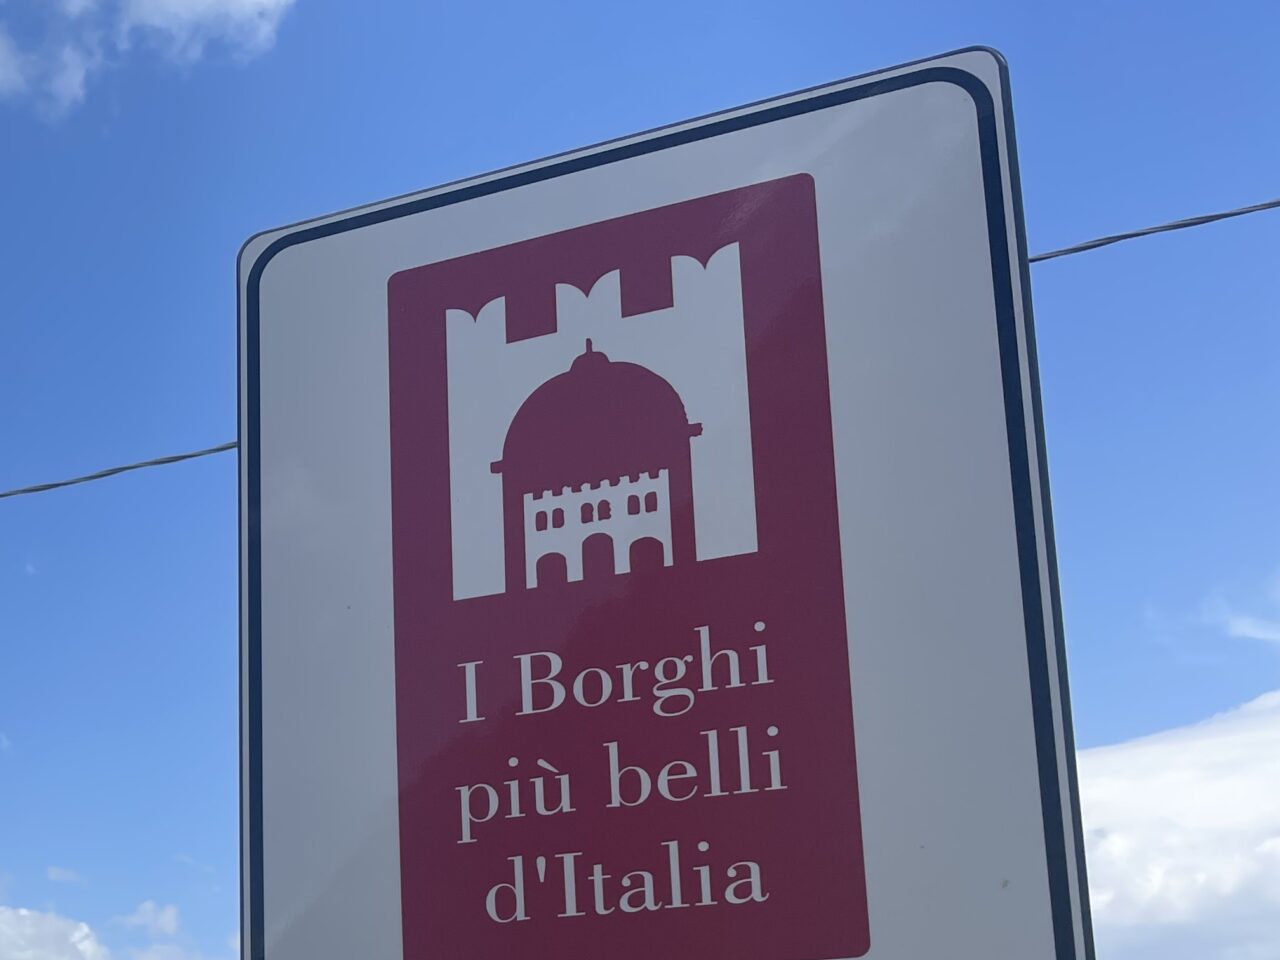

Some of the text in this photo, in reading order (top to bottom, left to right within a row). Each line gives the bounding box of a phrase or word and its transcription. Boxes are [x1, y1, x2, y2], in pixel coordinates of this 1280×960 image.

[457, 621, 775, 723] I Borghi
[455, 725, 788, 845] più belli
[485, 840, 770, 923] d'Italia
